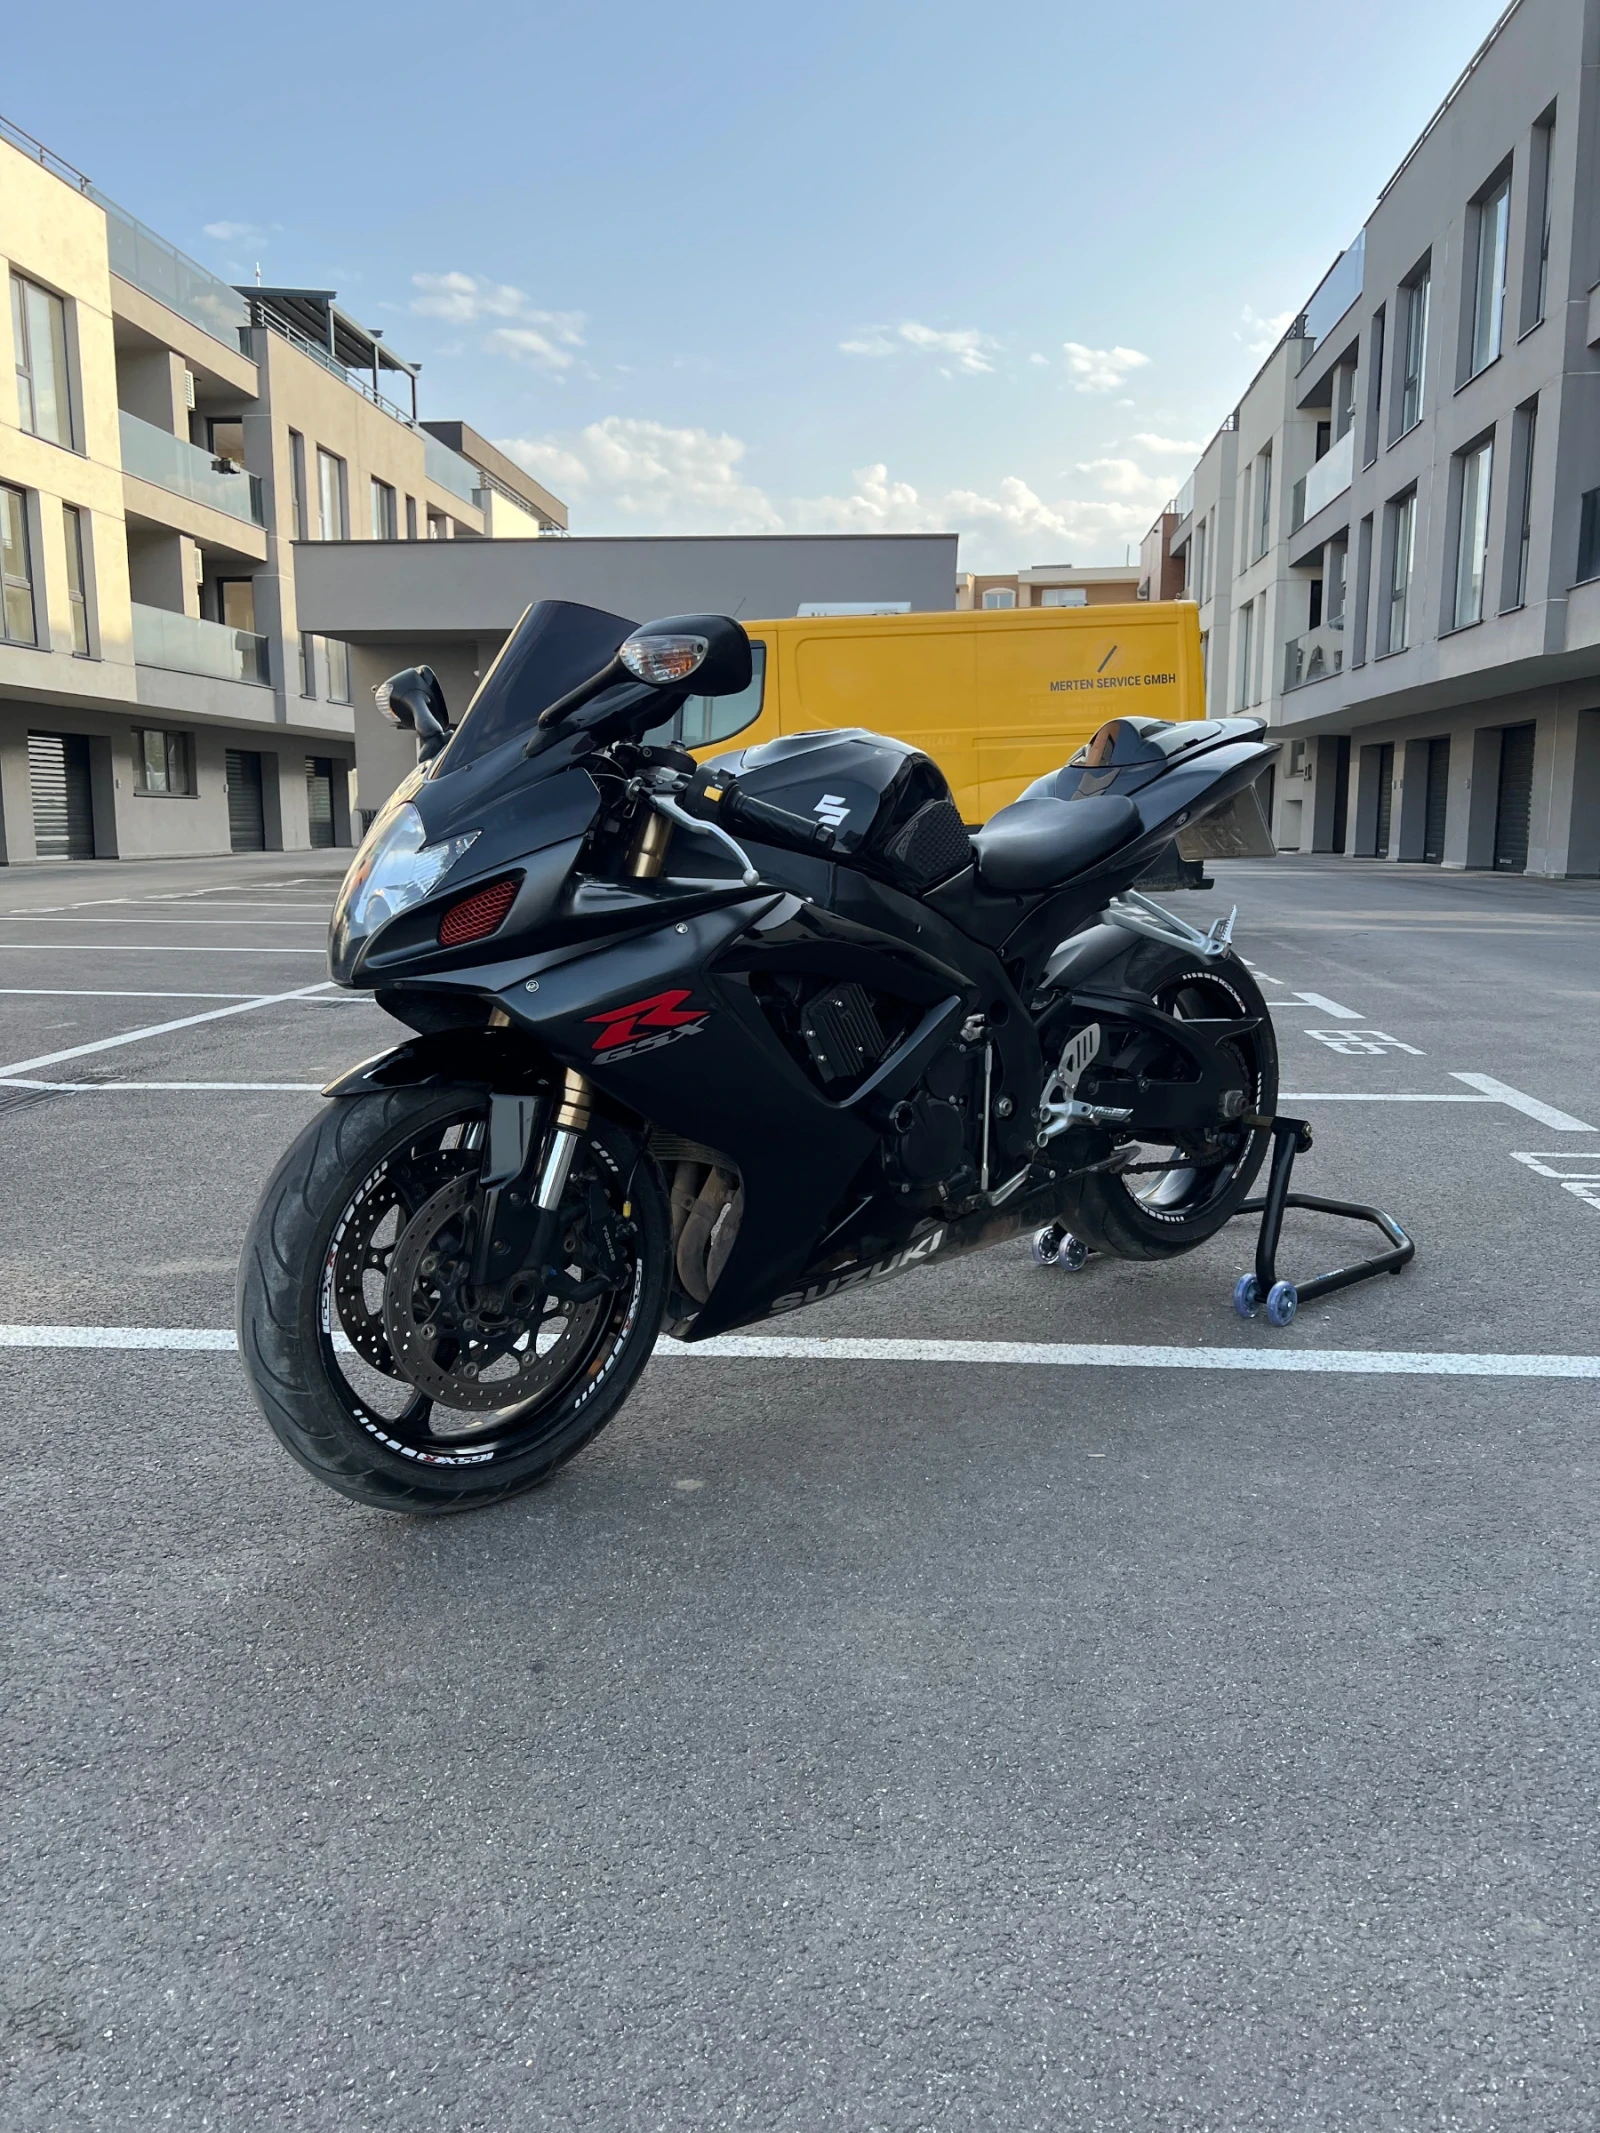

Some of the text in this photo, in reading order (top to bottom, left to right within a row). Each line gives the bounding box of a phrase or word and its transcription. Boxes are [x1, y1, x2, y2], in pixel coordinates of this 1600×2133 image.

[1050, 673, 1176, 692] MERTEN SERVICE GMBH
[591, 1015, 711, 1065] GSX
[602, 1224, 616, 1262] TOKICO
[768, 1228, 944, 1315] SUZUKI
